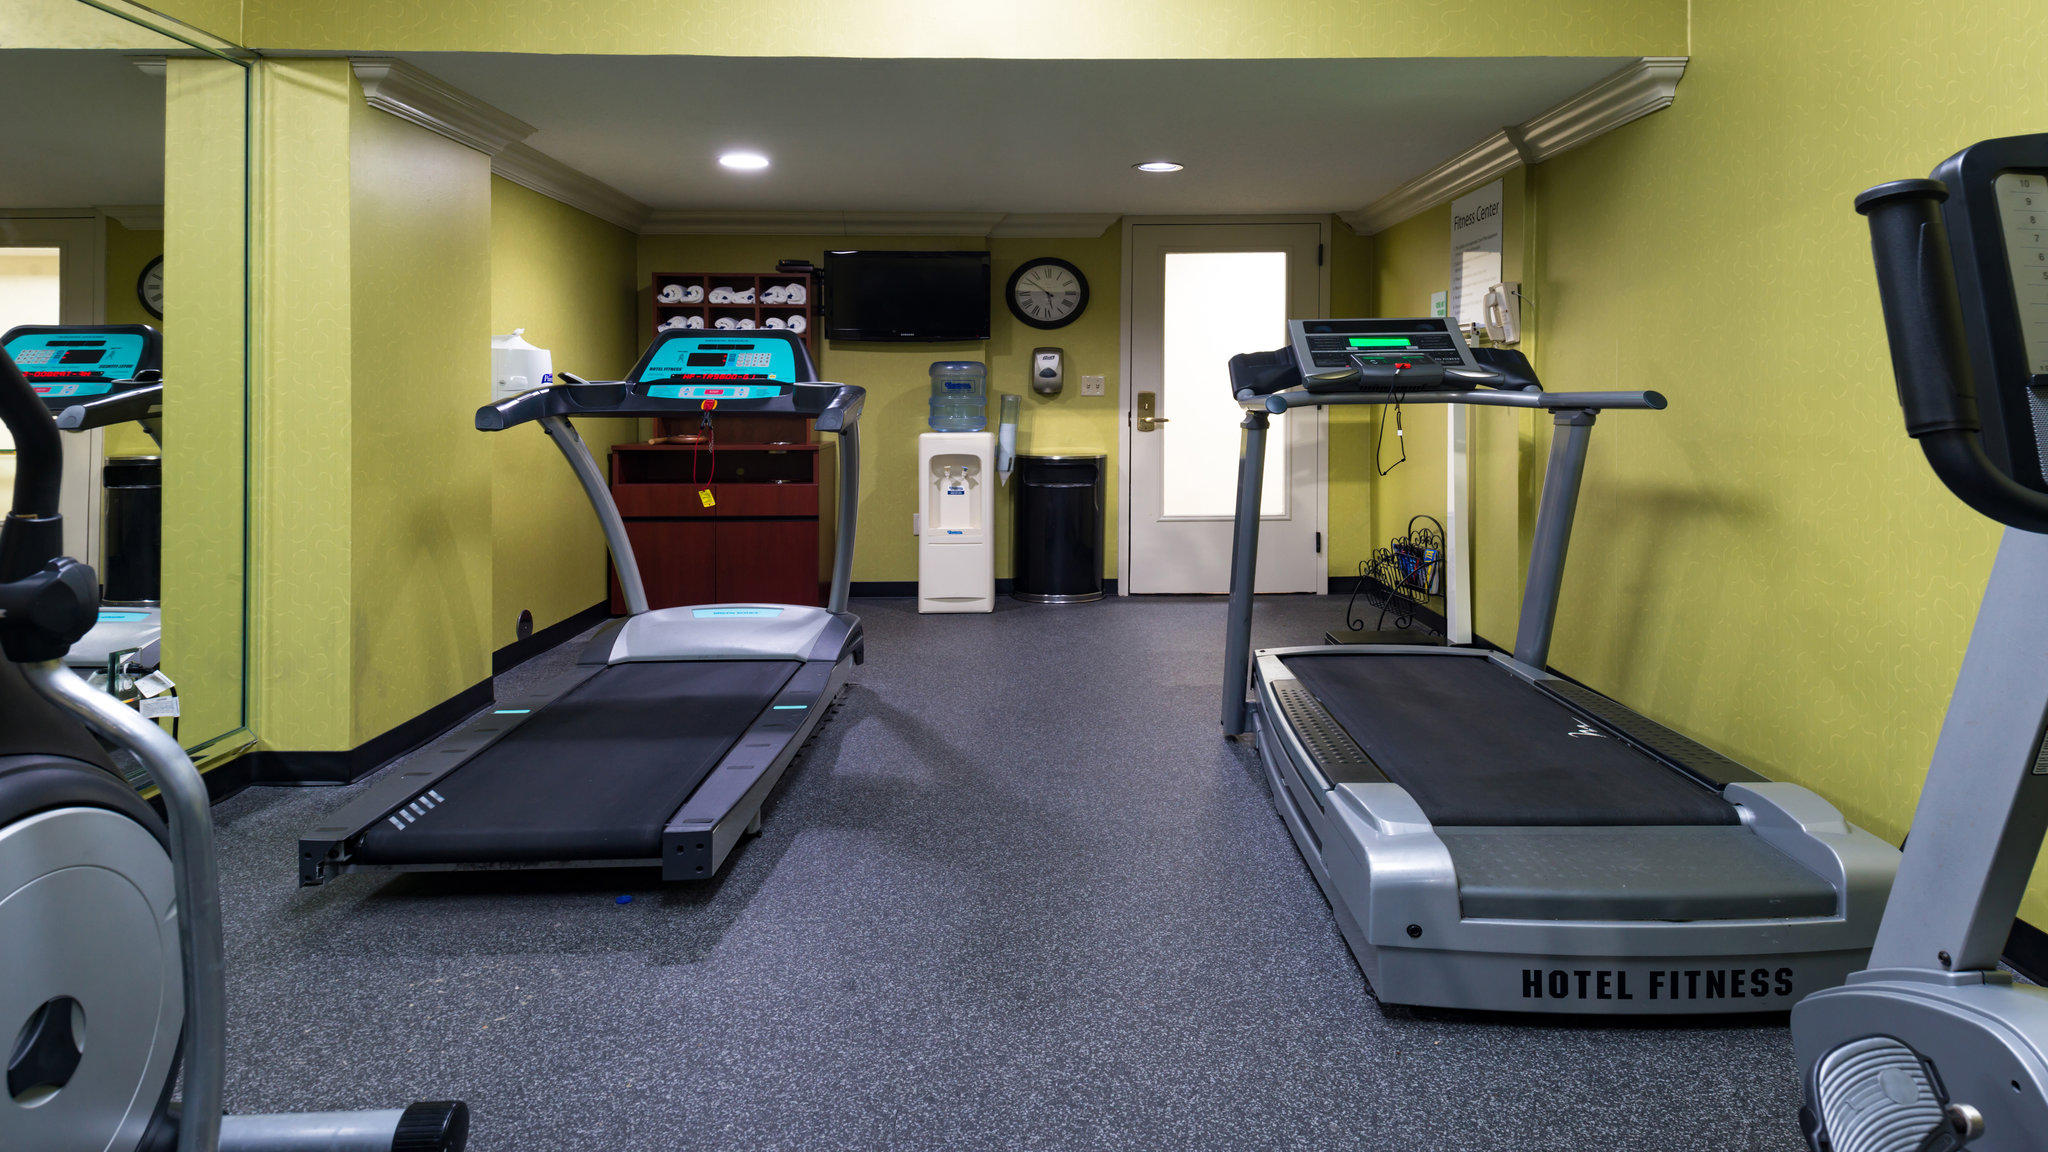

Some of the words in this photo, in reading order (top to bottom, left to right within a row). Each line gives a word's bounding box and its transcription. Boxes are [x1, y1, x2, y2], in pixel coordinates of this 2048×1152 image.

[2020, 179, 2030, 188] 10
[2025, 197, 2032, 206] 9
[1454, 212, 1475, 231] Fitness
[1477, 202, 1499, 221] Center
[2029, 215, 2036, 224] 8
[2034, 234, 2040, 242] 7
[2039, 253, 2045, 261] 6
[1522, 969, 1633, 1000] HOTEL
[1649, 967, 1794, 1000] FITNESS
